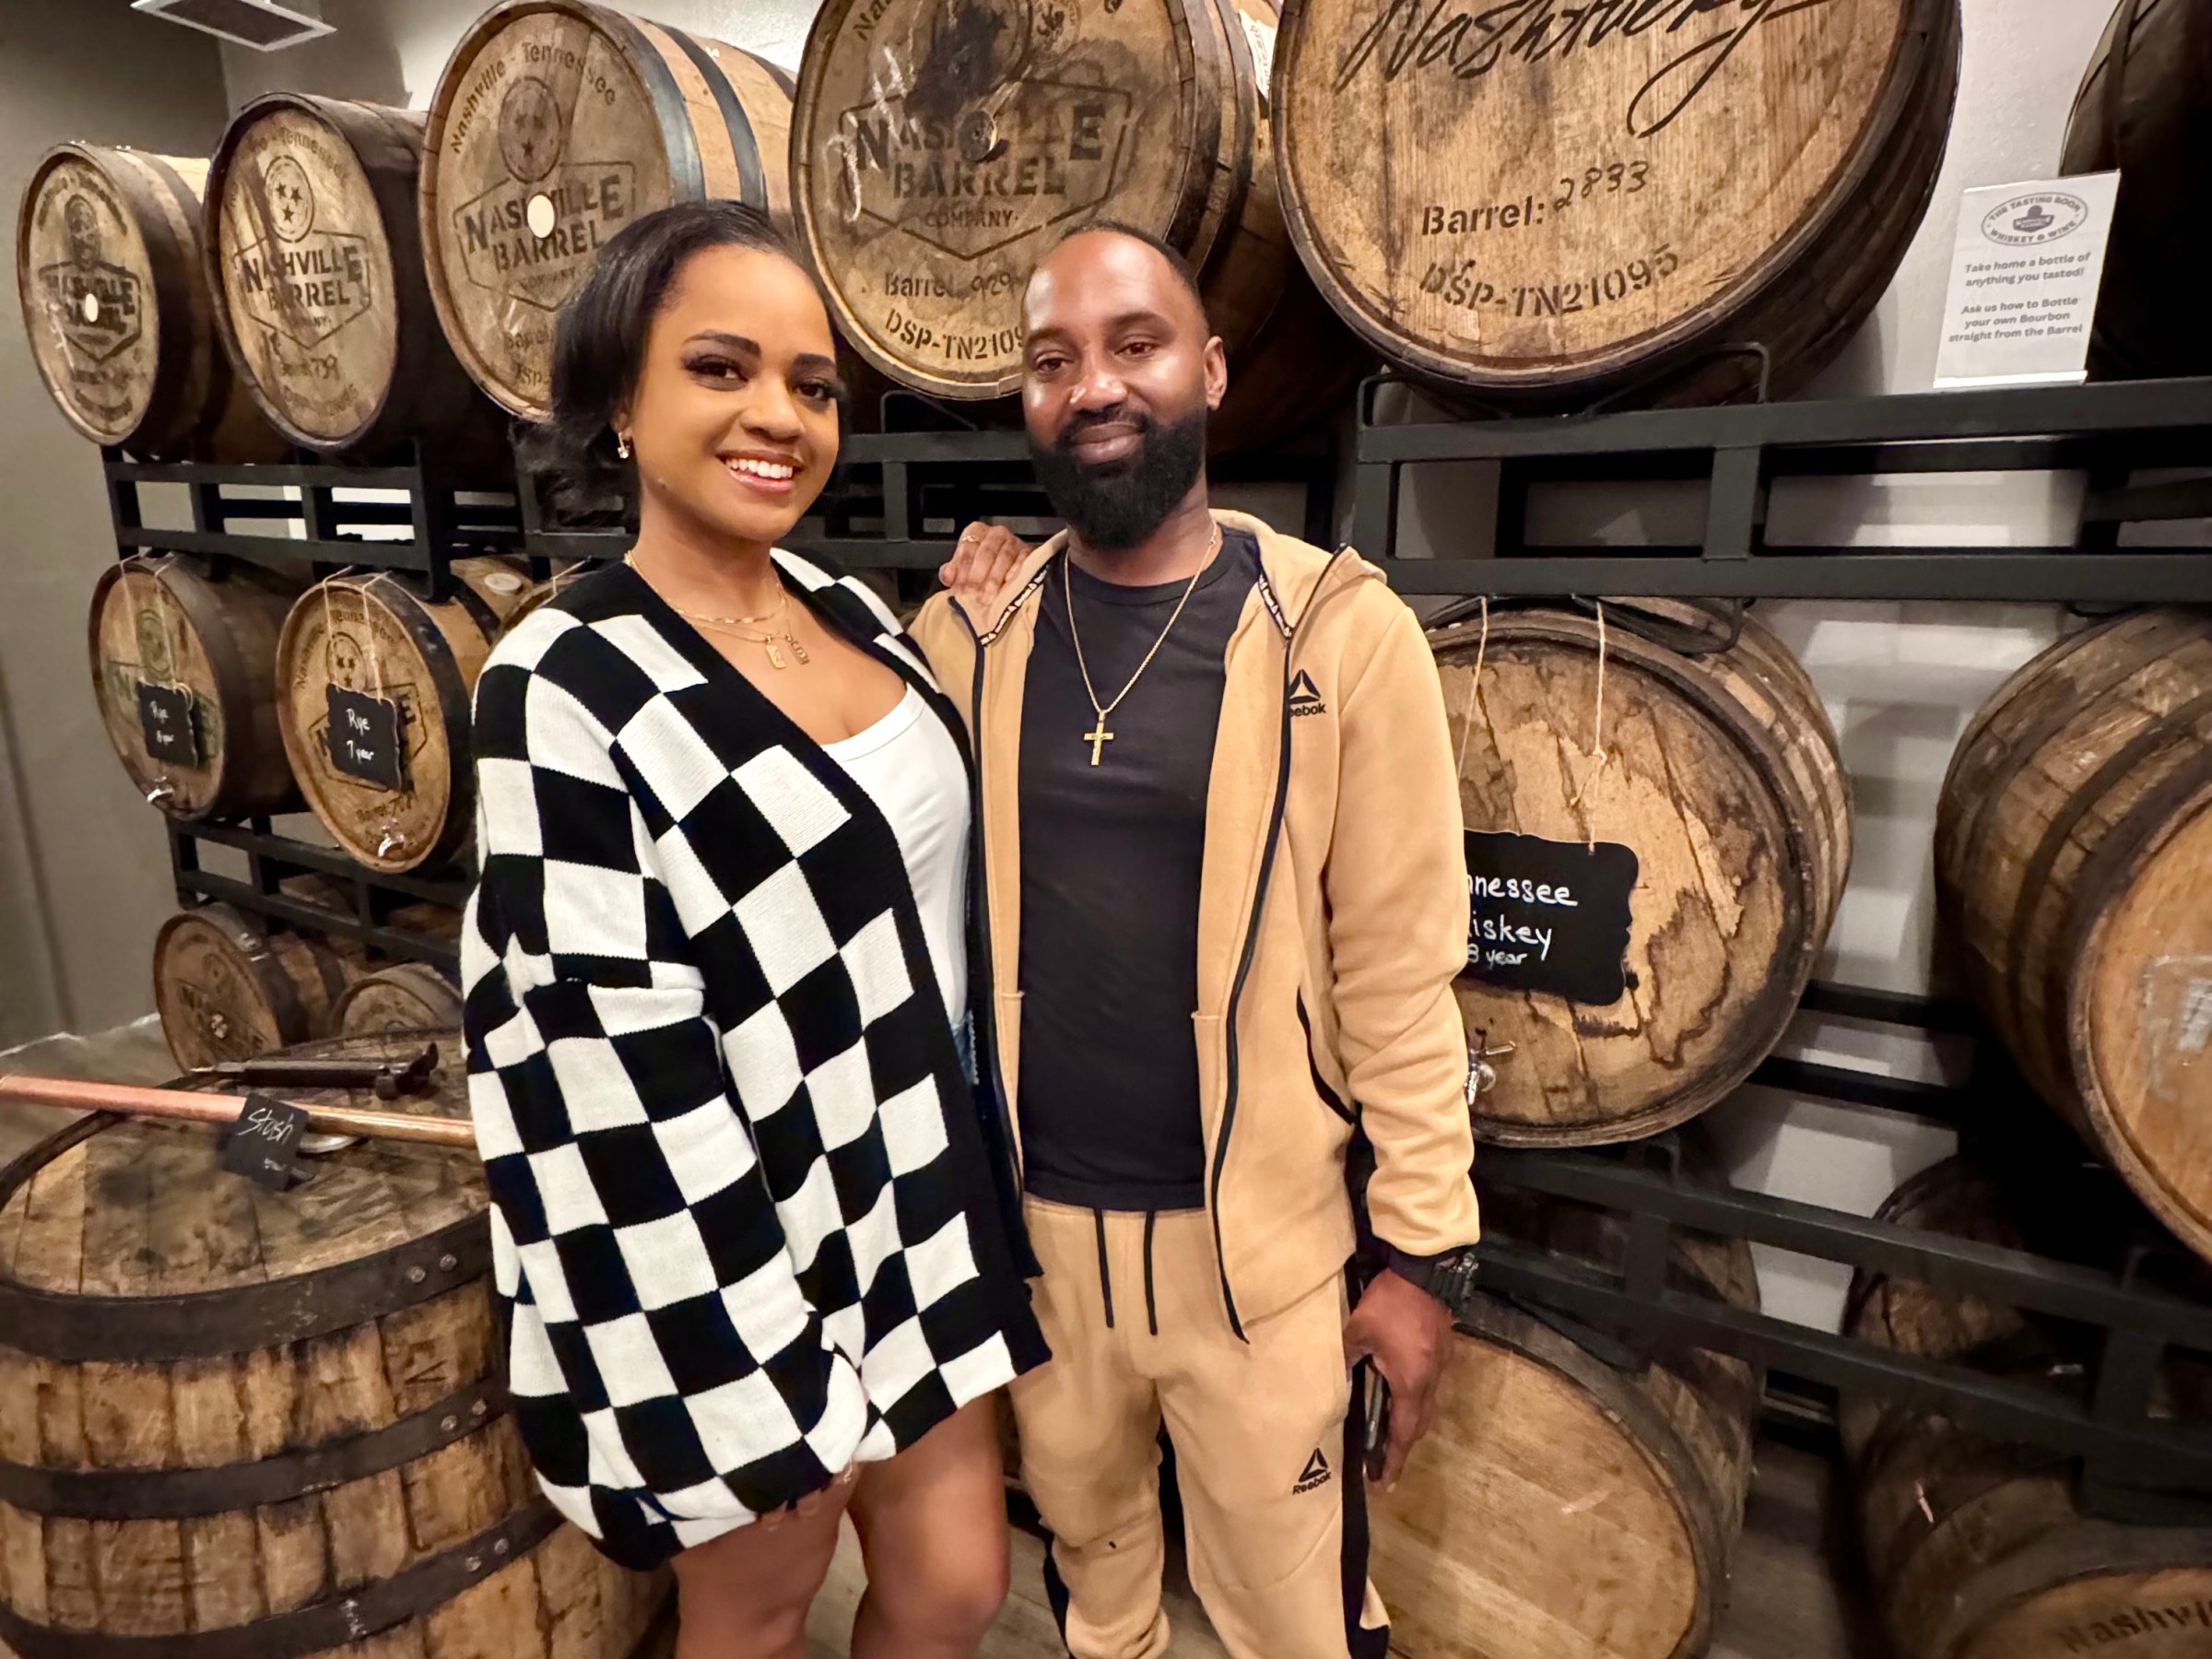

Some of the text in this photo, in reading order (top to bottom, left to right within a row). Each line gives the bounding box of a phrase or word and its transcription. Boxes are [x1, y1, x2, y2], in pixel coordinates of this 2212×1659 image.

[522, 41, 617, 107] Tennessee
[893, 154, 1066, 199] BARREL
[1421, 194, 1545, 236] Barrel:
[1989, 195, 2081, 221] THE TASTING ROOM
[1991, 228, 2034, 243] WHISKEY
[2048, 220, 2077, 238] WINE
[491, 219, 606, 274] BARREL
[1965, 264, 1992, 274] Take
[1994, 259, 2027, 271] home
[2039, 254, 2074, 267] bottle
[2077, 252, 2091, 263] of
[1419, 242, 1679, 318] DSP-TN21095
[1966, 275, 2016, 288] anything
[2018, 273, 2040, 284] you
[267, 279, 351, 312] BRREL
[1961, 297, 2078, 315] Ask us how to Bottle
[1948, 324, 2083, 343] straight from the Barrel
[1964, 312, 2070, 330] your own Bourbon
[346, 708, 371, 736] Rye
[1469, 911, 1553, 961] iskey
[1486, 949, 1528, 970] year
[1292, 1471, 1332, 1496] Reebok
